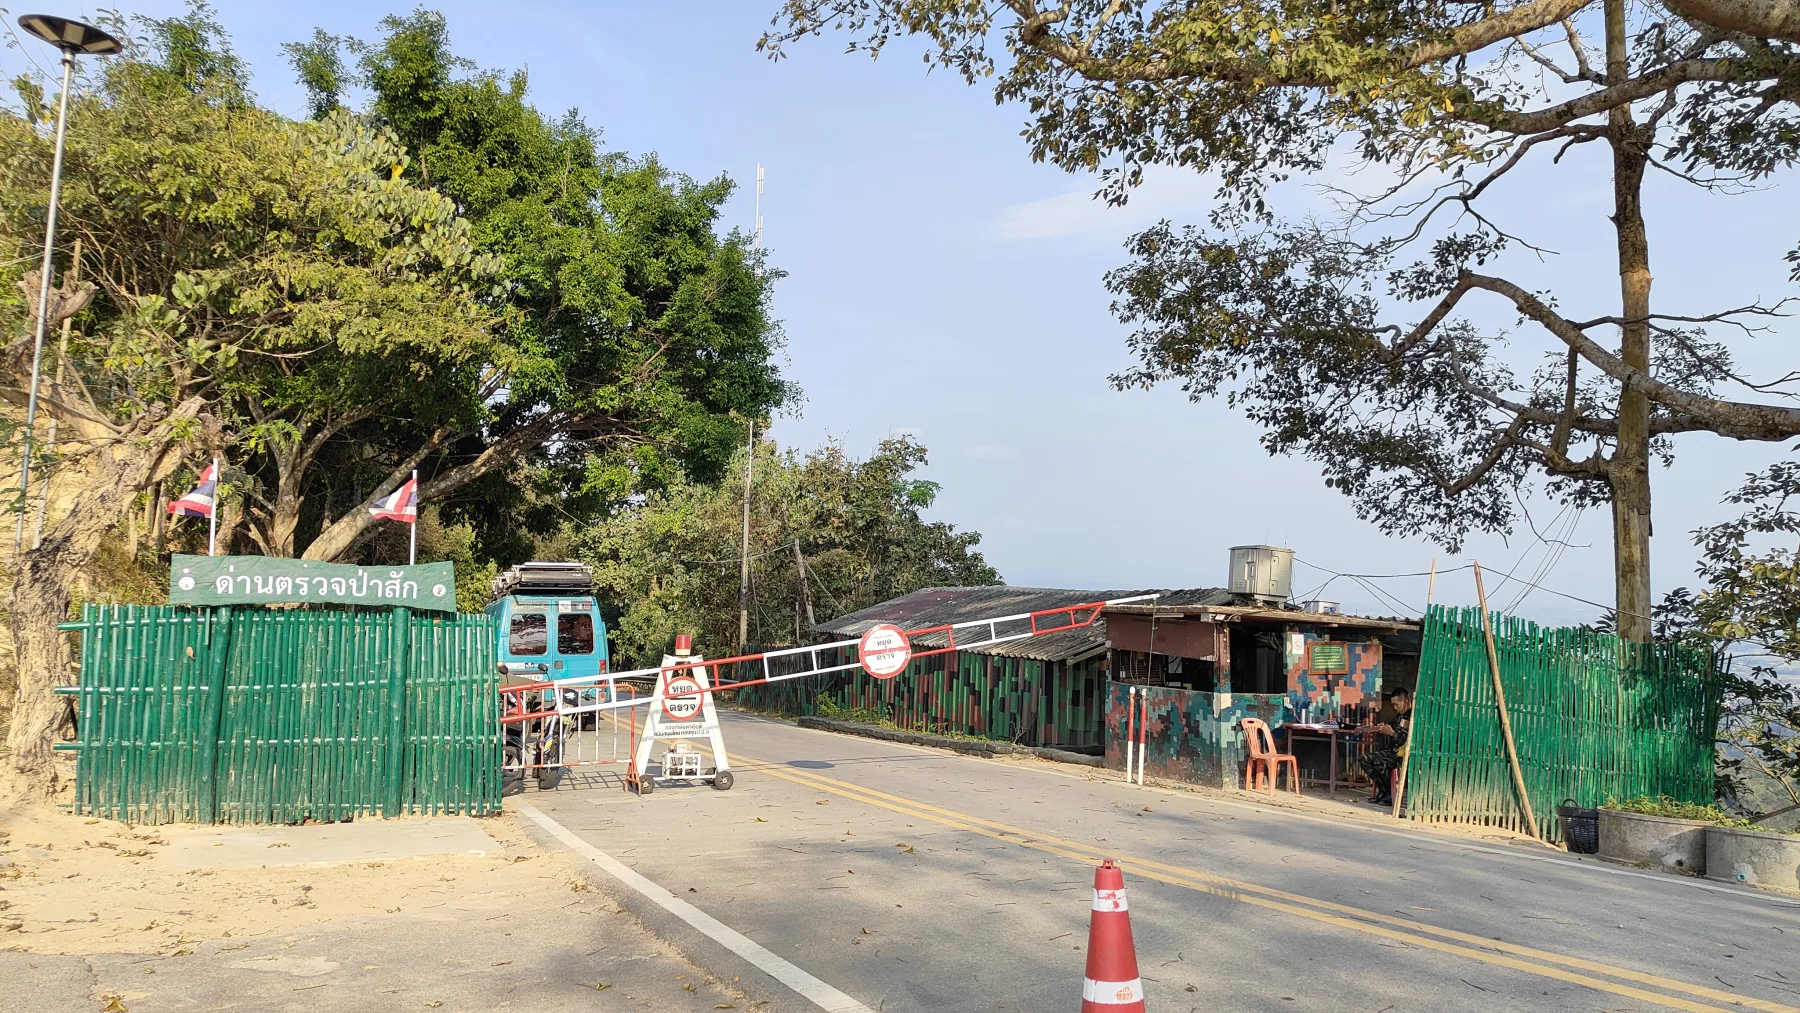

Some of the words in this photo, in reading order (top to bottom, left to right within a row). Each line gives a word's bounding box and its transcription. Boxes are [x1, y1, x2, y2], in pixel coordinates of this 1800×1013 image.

[216, 565, 418, 599] ด่านตรวจป่าสัก
